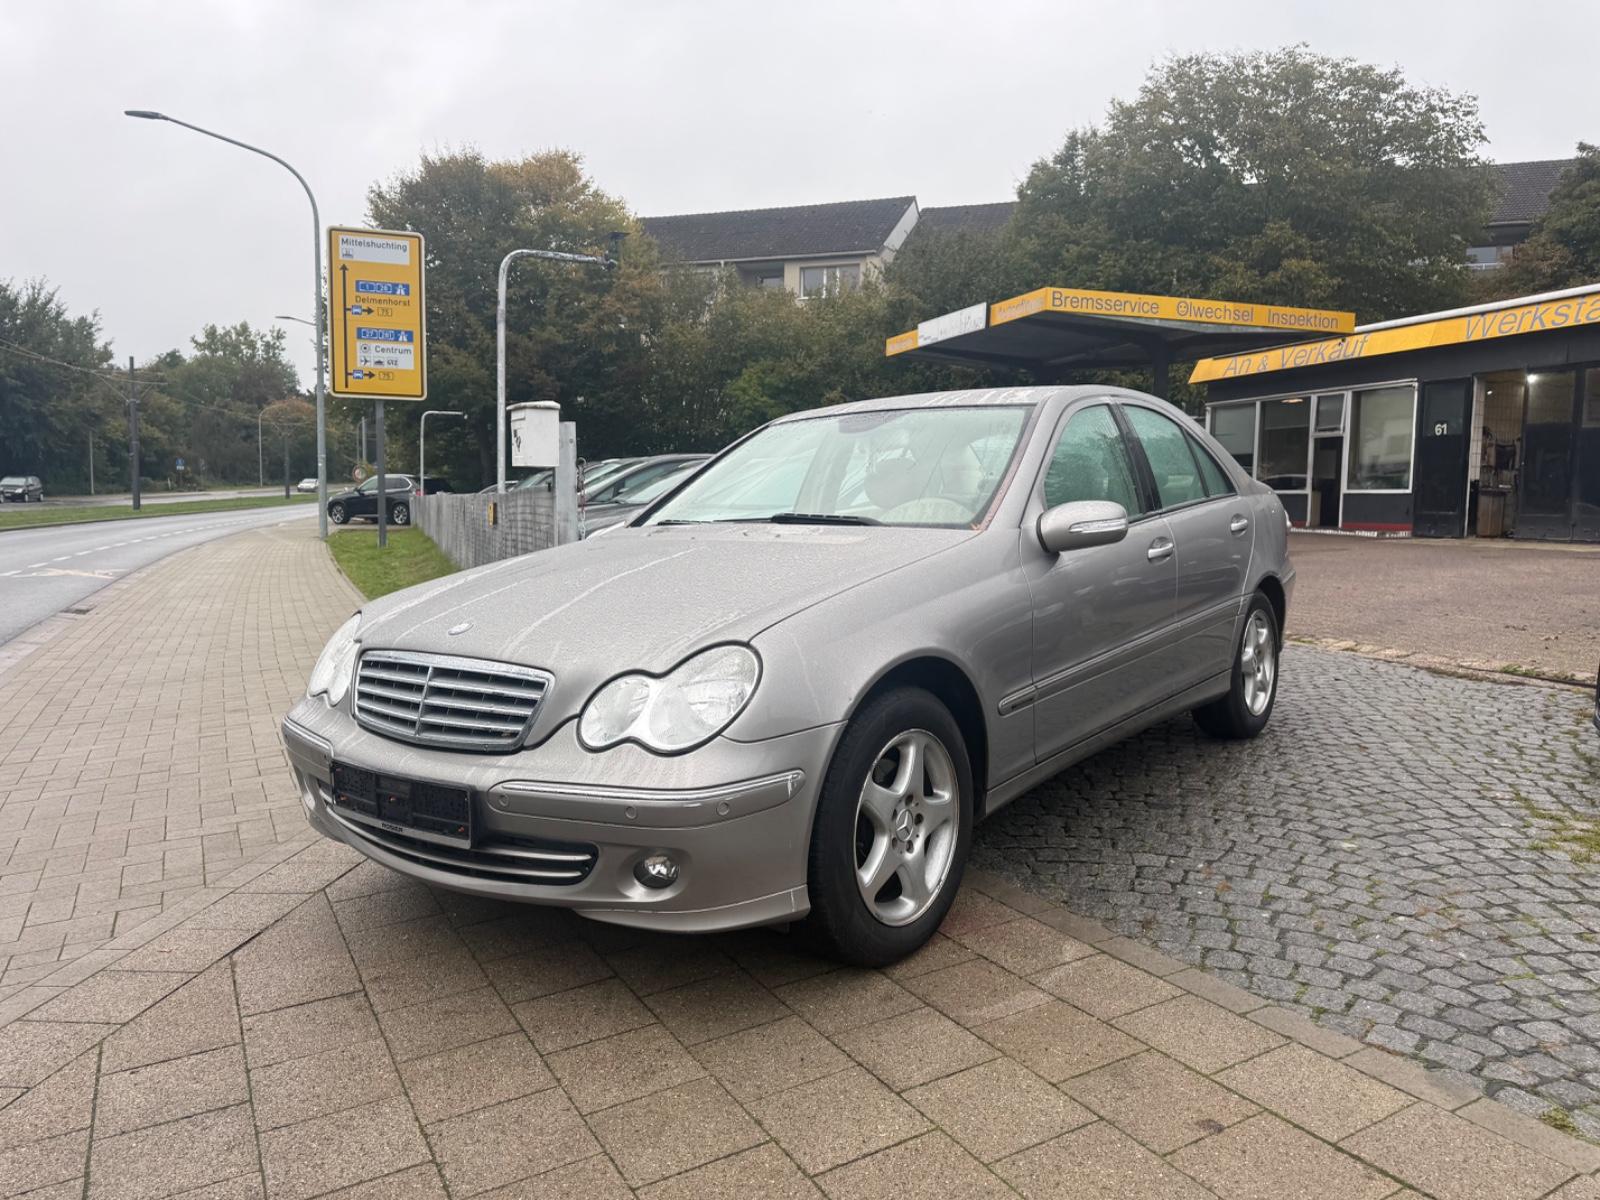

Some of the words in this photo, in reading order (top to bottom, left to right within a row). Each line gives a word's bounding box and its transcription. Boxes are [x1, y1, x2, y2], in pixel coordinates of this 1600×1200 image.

[355, 295, 410, 306] Delmenhorst
[1051, 290, 1160, 316] Bremsservice
[1268, 308, 1339, 330] Inspektion
[374, 345, 412, 355] Centrum
[1222, 358, 1252, 377] An
[1256, 354, 1269, 372] &
[1279, 334, 1369, 370] Verkauf
[1434, 423, 1448, 436] 61
